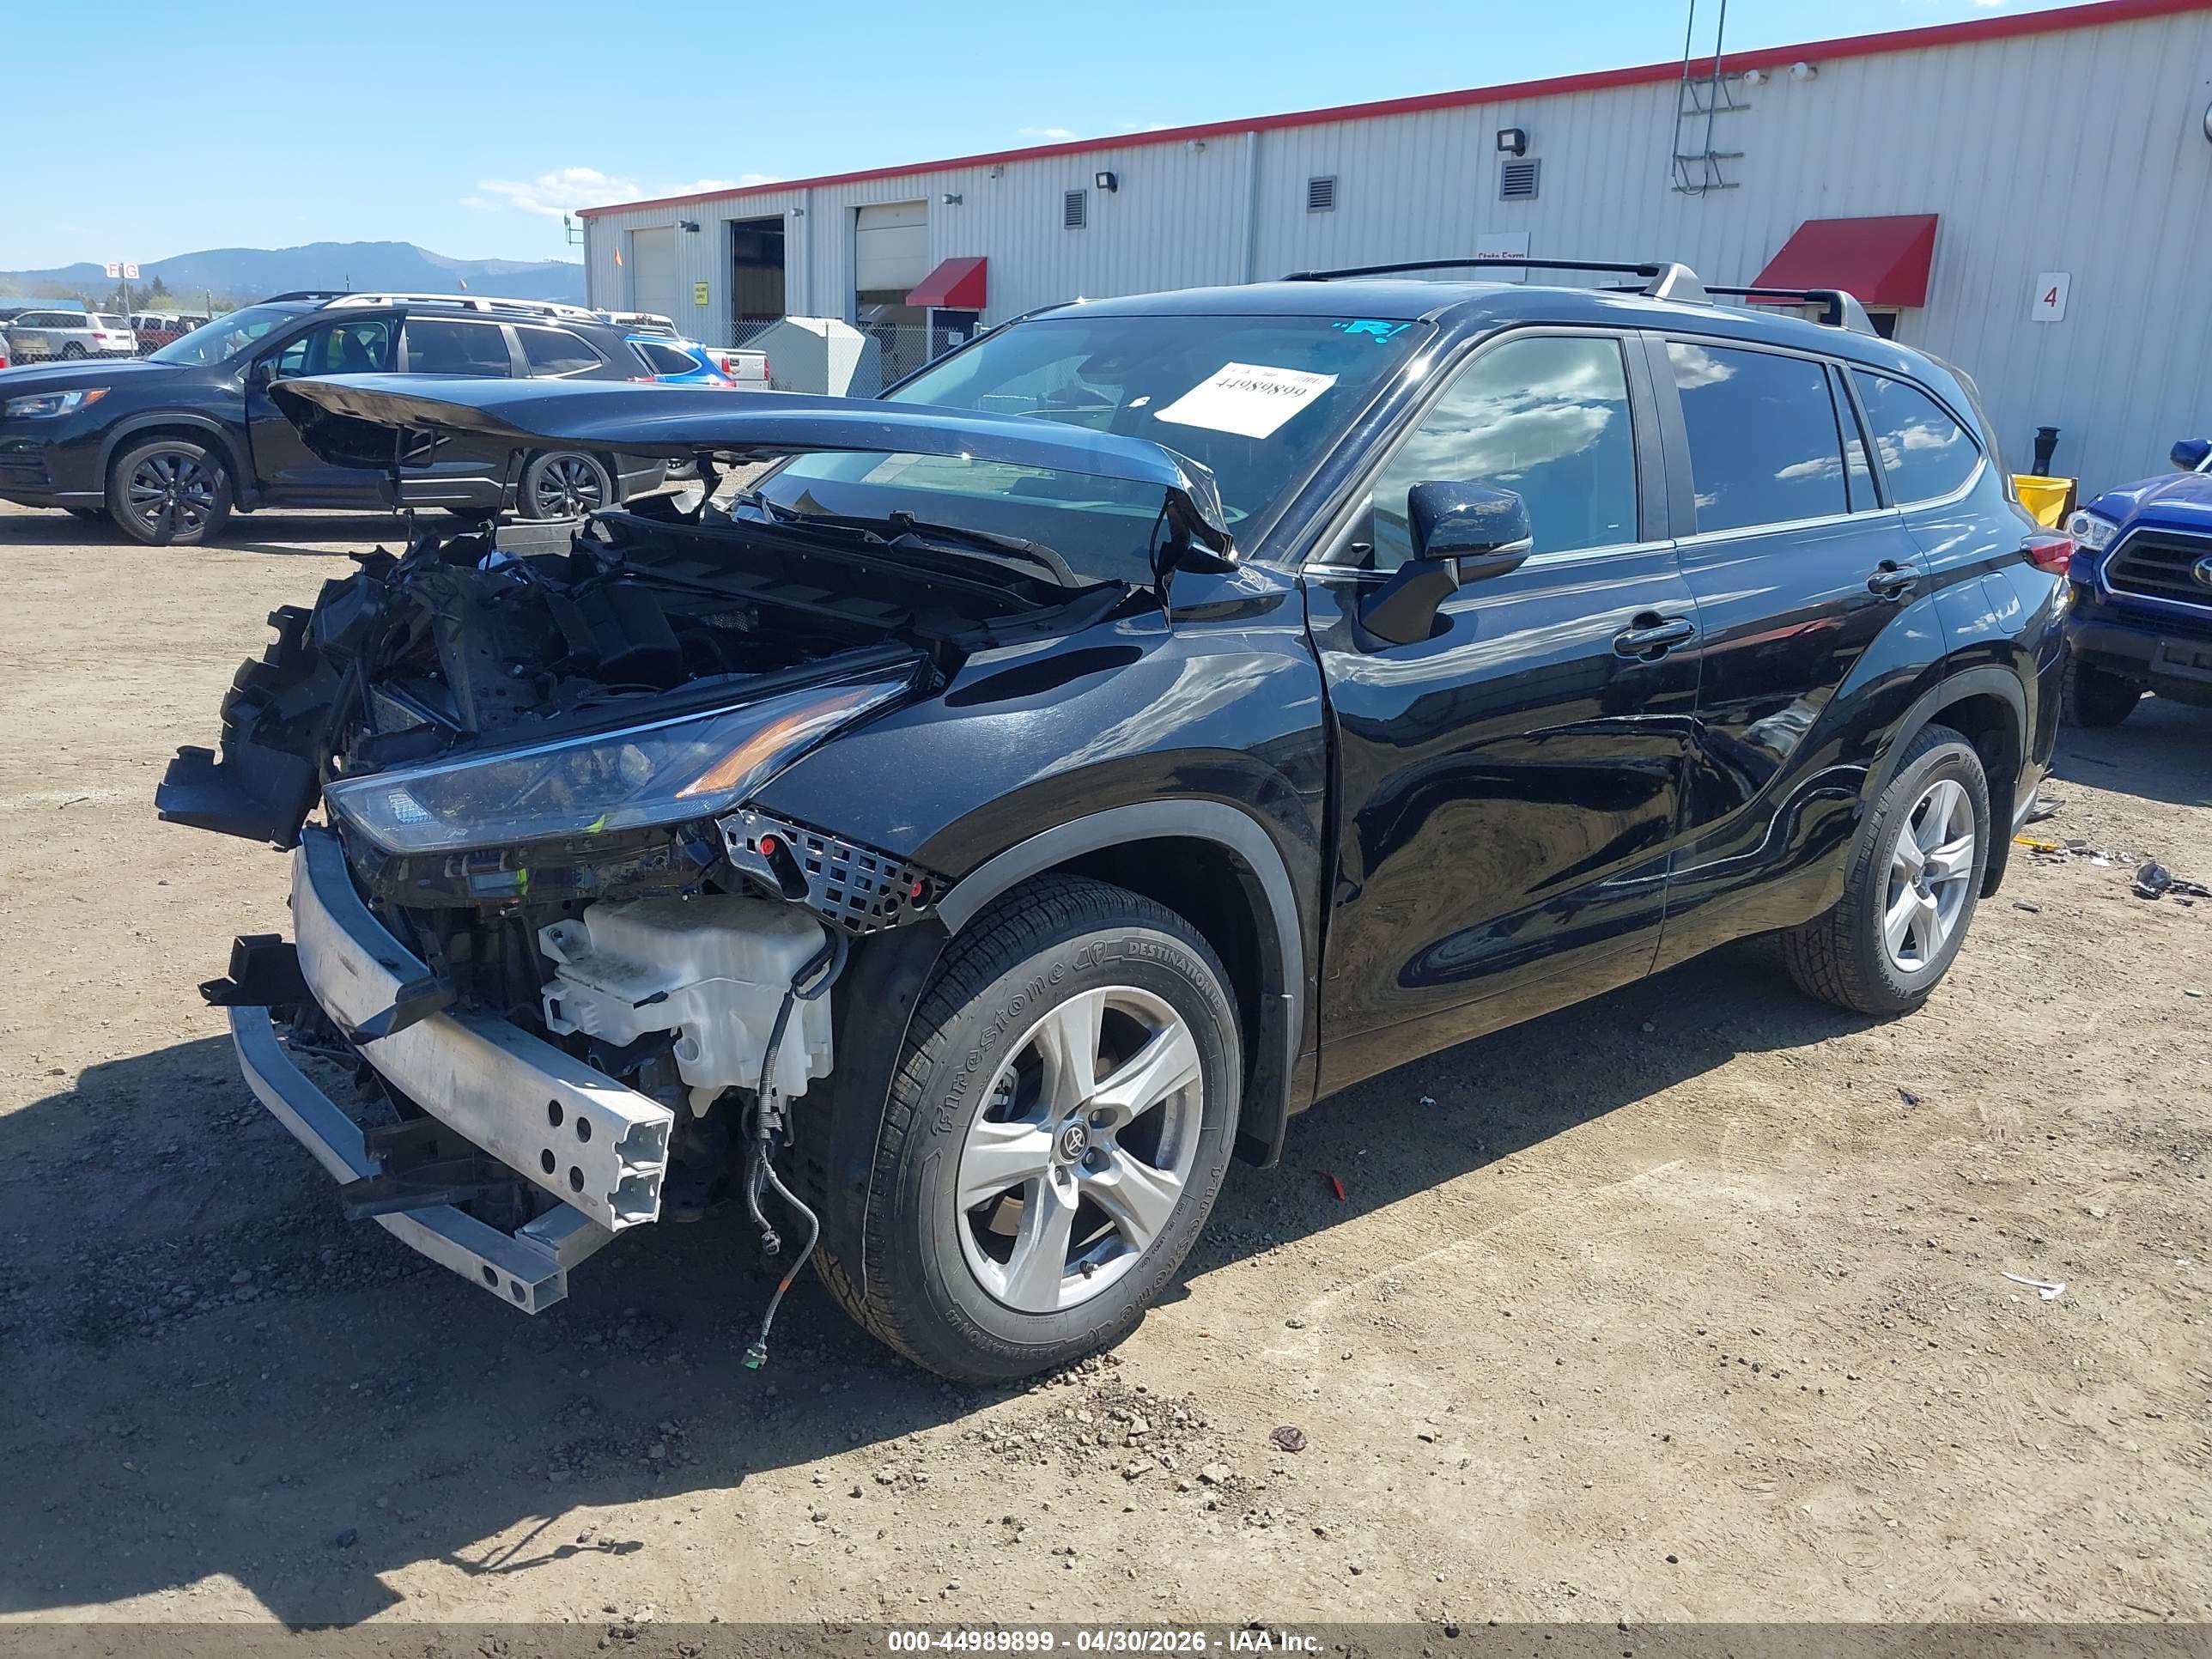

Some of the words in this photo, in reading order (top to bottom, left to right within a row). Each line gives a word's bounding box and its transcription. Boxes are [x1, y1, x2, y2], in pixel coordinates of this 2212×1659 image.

[109, 264, 117, 276] F
[126, 264, 137, 276] G
[2044, 287, 2057, 307] 4
[1216, 378, 1308, 398] 44989899
[1128, 941, 1212, 996] DESTINATION
